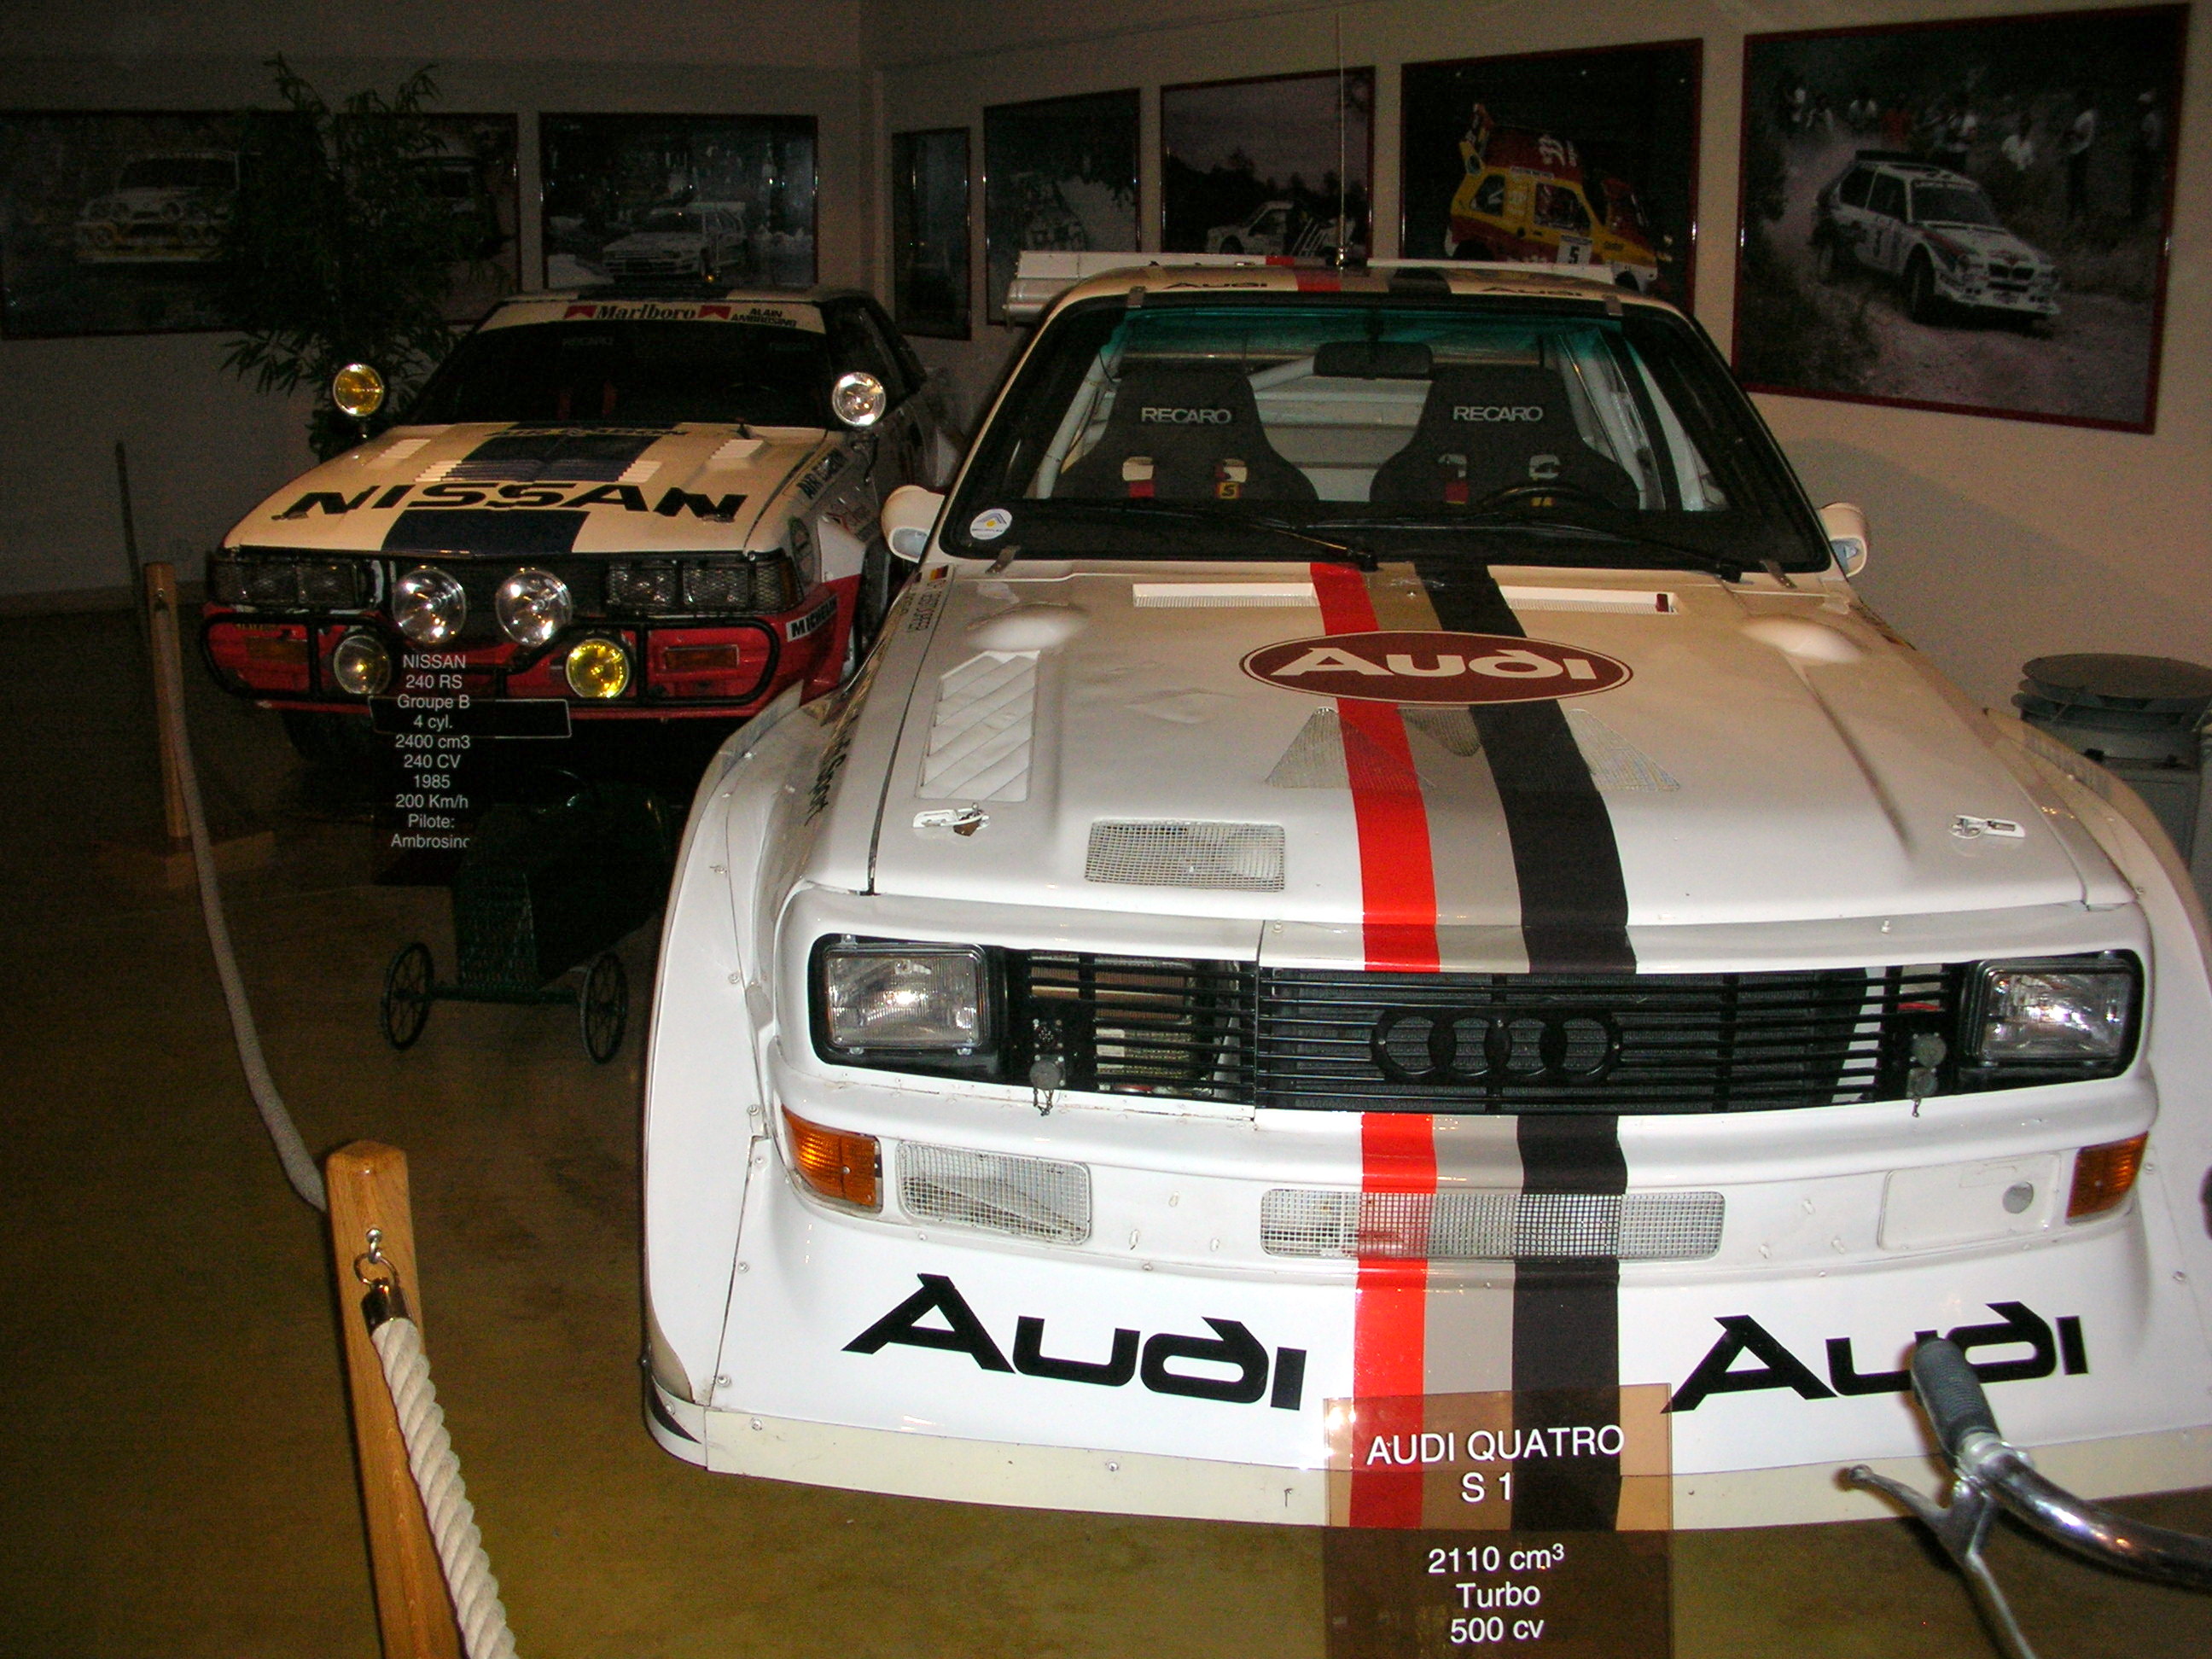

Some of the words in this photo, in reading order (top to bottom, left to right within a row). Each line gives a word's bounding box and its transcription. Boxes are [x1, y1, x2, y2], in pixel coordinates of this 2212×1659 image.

[599, 304, 696, 320] Marlboro
[748, 307, 783, 318] ALAIN
[1140, 406, 1232, 424] RECARO
[1452, 405, 1544, 422] RECARO
[280, 482, 748, 520] NISSAN
[402, 654, 467, 669] NISSAN
[1269, 646, 1598, 680] Audi
[405, 674, 434, 689] 240
[439, 674, 463, 689] RS
[397, 694, 454, 712] Groupe
[458, 694, 470, 709] B
[413, 715, 423, 728] 4
[428, 713, 453, 732] cyl.
[395, 734, 434, 748] 2400
[438, 735, 470, 748] cm3
[404, 754, 433, 769] 240
[437, 754, 462, 769] CV
[414, 774, 451, 789] 1985
[395, 794, 425, 808] 200
[428, 794, 469, 809] Km/h
[408, 813, 455, 829] Pilote:
[840, 1272, 1307, 1412] Audi
[1660, 1301, 2089, 1414] Audi
[1366, 1431, 1454, 1465] AUDI
[1467, 1423, 1626, 1463] QUATRO
[1461, 1471, 1486, 1503] S
[1499, 1471, 1512, 1501] 1
[1428, 1545, 1500, 1574] 2110
[1455, 1581, 1541, 1609] Turbo
[1450, 1616, 1504, 1644] 500
[1513, 1618, 1545, 1639] cv
